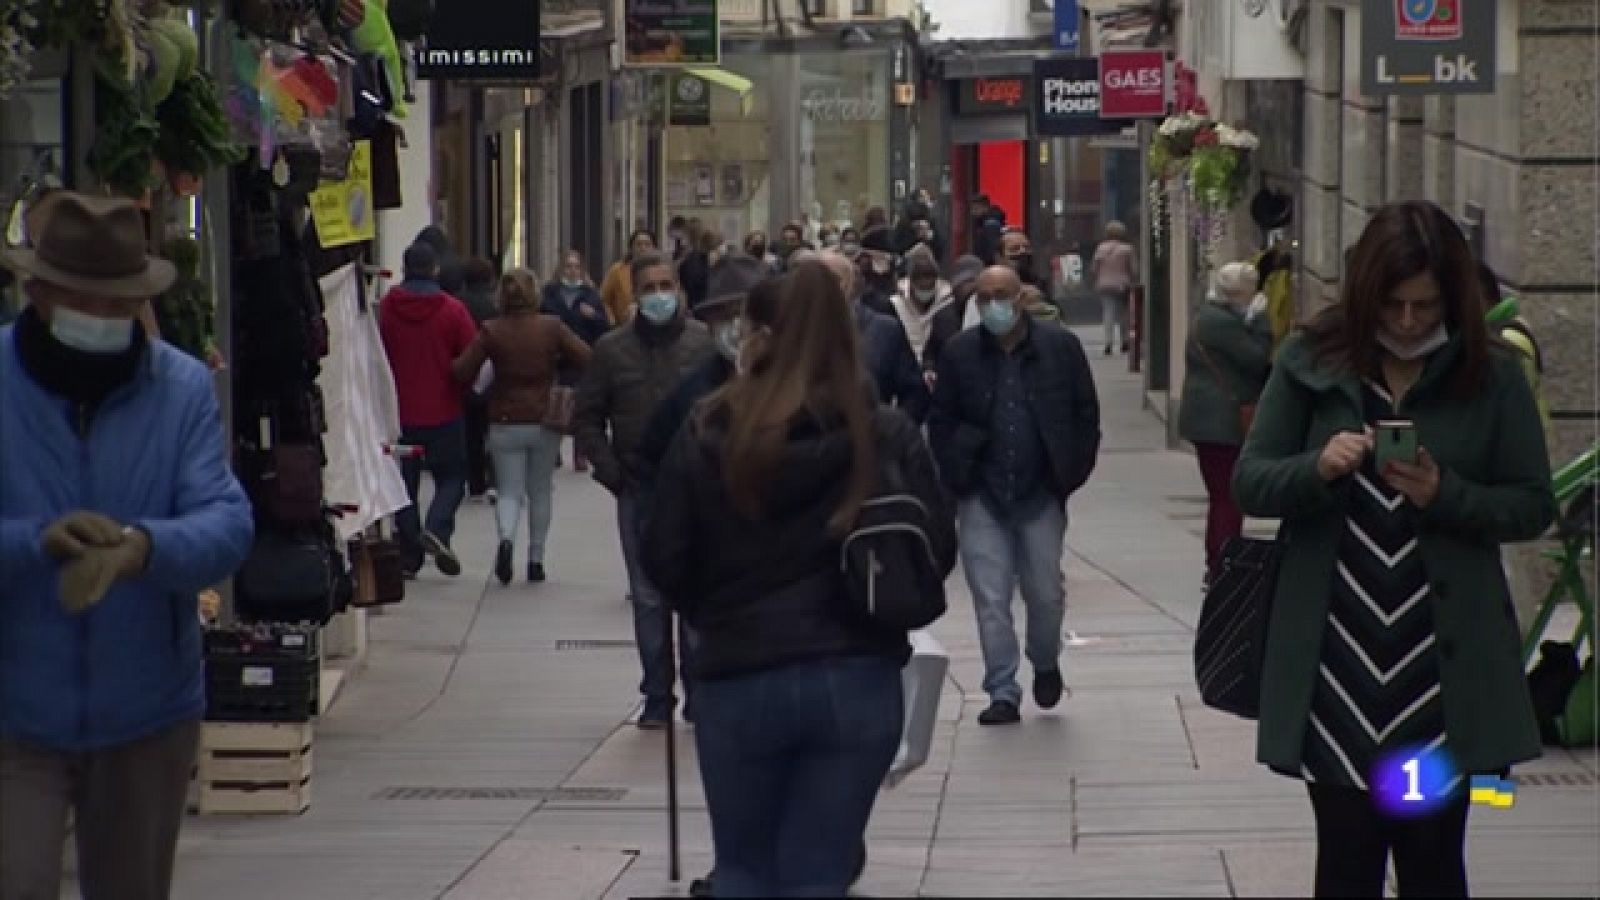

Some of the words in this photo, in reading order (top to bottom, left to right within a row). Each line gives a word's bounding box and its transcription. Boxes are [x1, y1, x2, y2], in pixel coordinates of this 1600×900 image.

[418, 48, 533, 66] imissimi
[1044, 79, 1101, 96] Phon
[1104, 68, 1162, 89] GAES
[976, 78, 1023, 106] Orange
[1044, 95, 1101, 113] Hous
